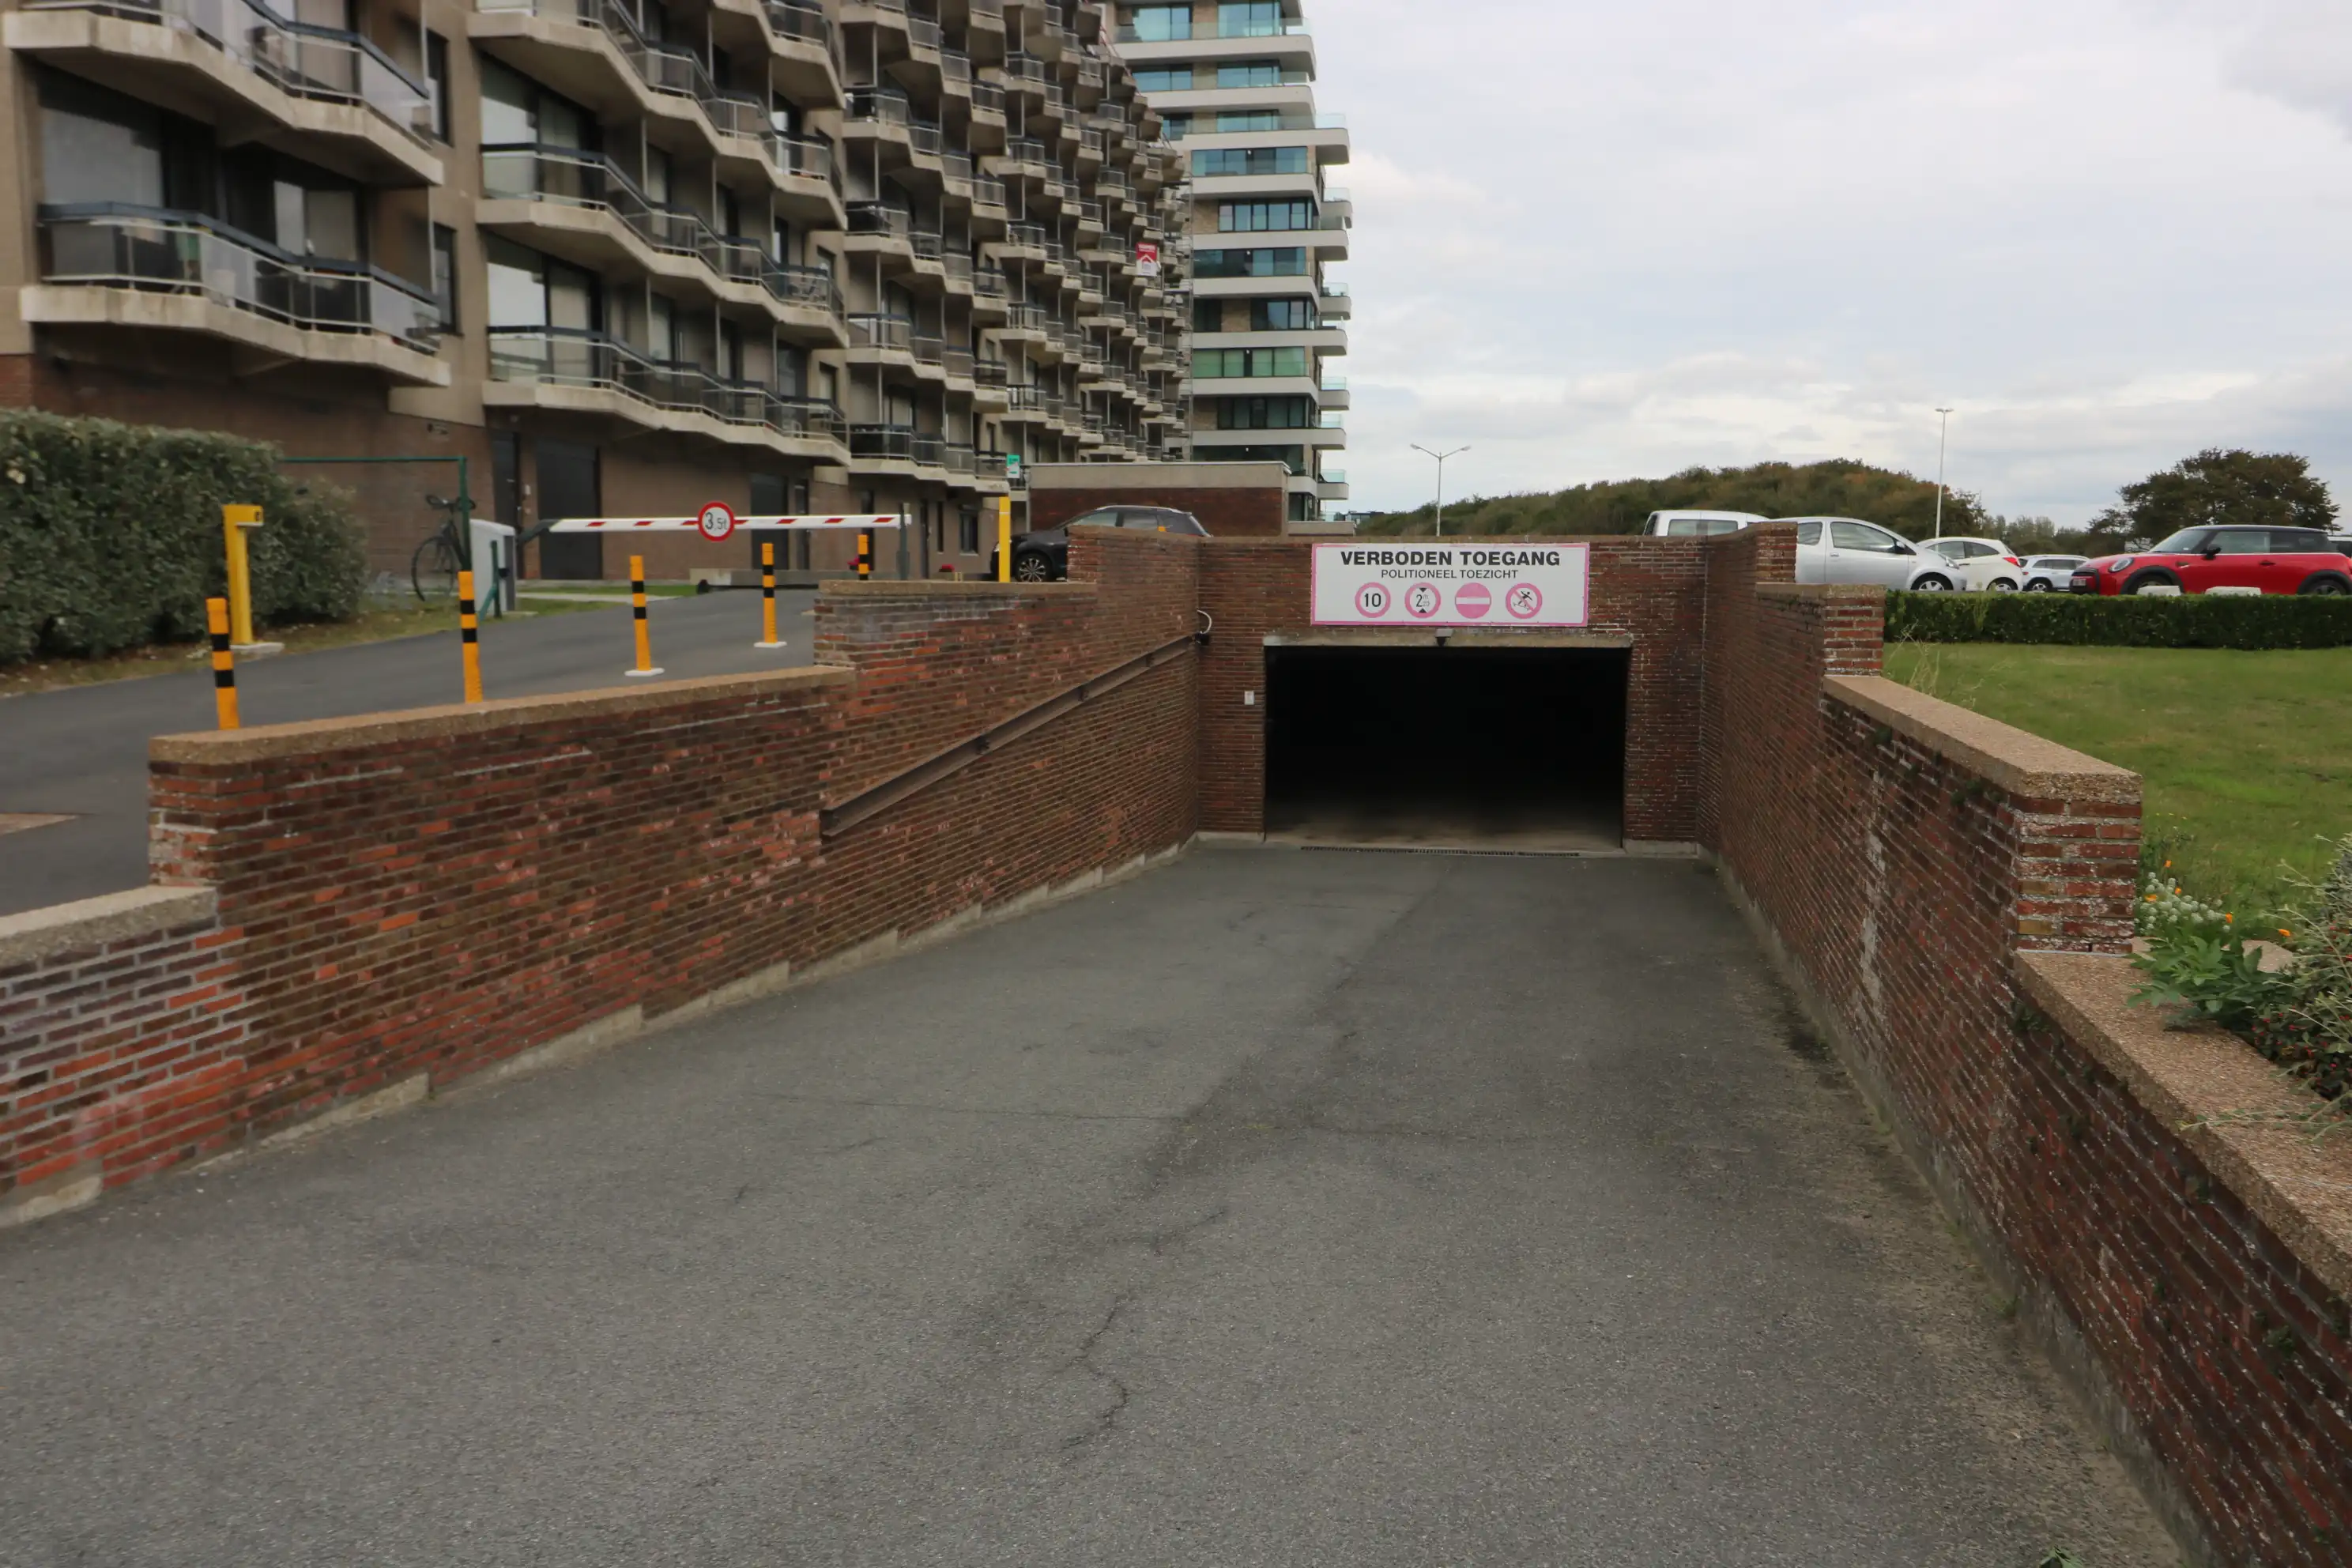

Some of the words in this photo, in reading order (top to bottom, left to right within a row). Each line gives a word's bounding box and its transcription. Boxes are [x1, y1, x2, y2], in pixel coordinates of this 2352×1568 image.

[1340, 551, 1452, 566] VERBODEN
[1459, 551, 1560, 567] TOEGANG
[1381, 569, 1457, 579] POLITIONEEL
[1460, 569, 1518, 579] TOEZICHT
[1364, 593, 1381, 607] 10
